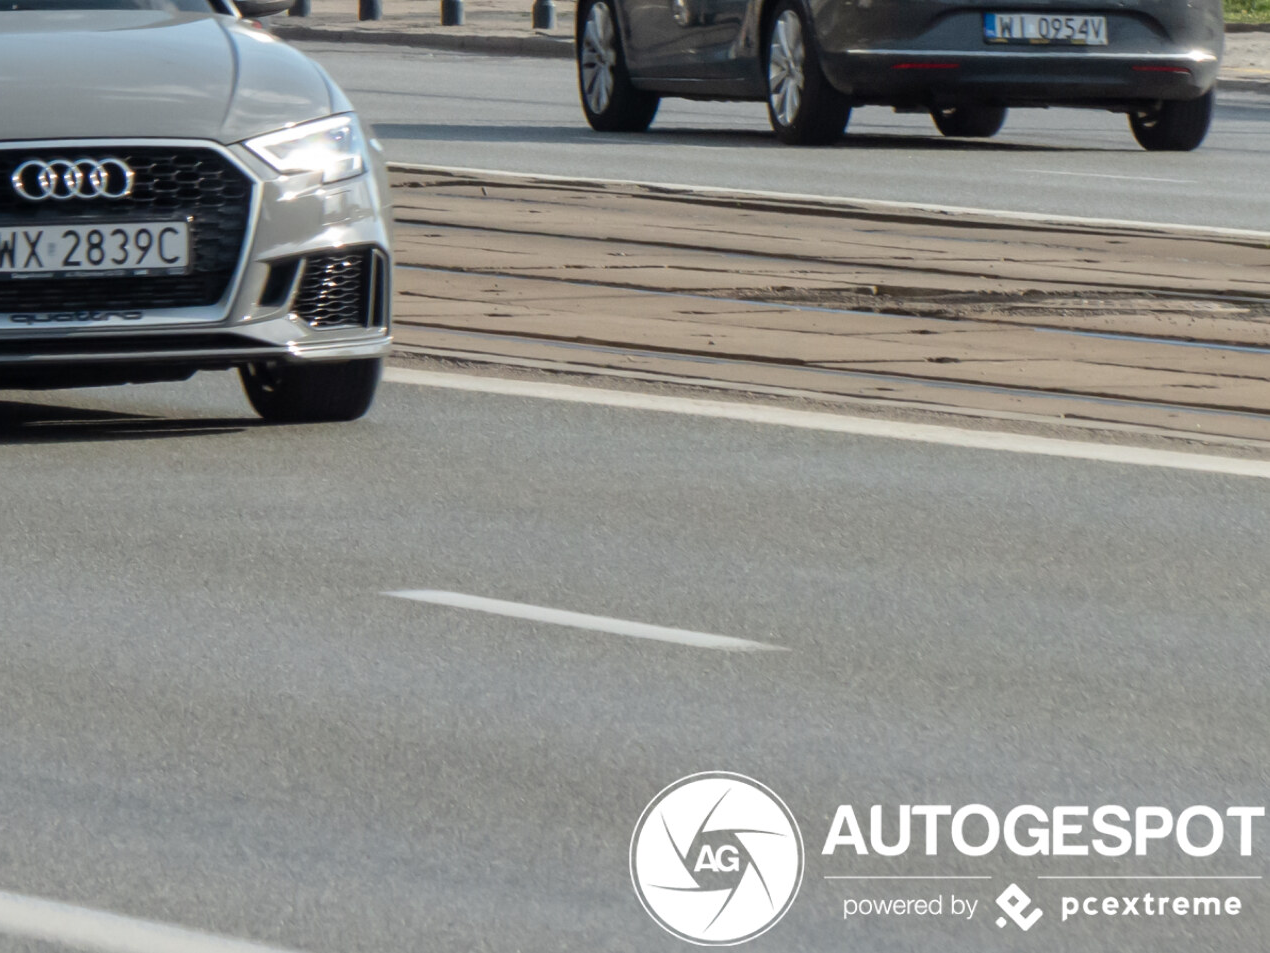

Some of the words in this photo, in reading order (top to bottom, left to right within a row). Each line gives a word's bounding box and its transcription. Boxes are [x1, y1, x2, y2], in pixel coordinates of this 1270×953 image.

[999, 16, 1026, 39] WI
[1038, 16, 1103, 40] 0954V
[62, 227, 179, 267] 2839C
[10, 311, 142, 325] quattro
